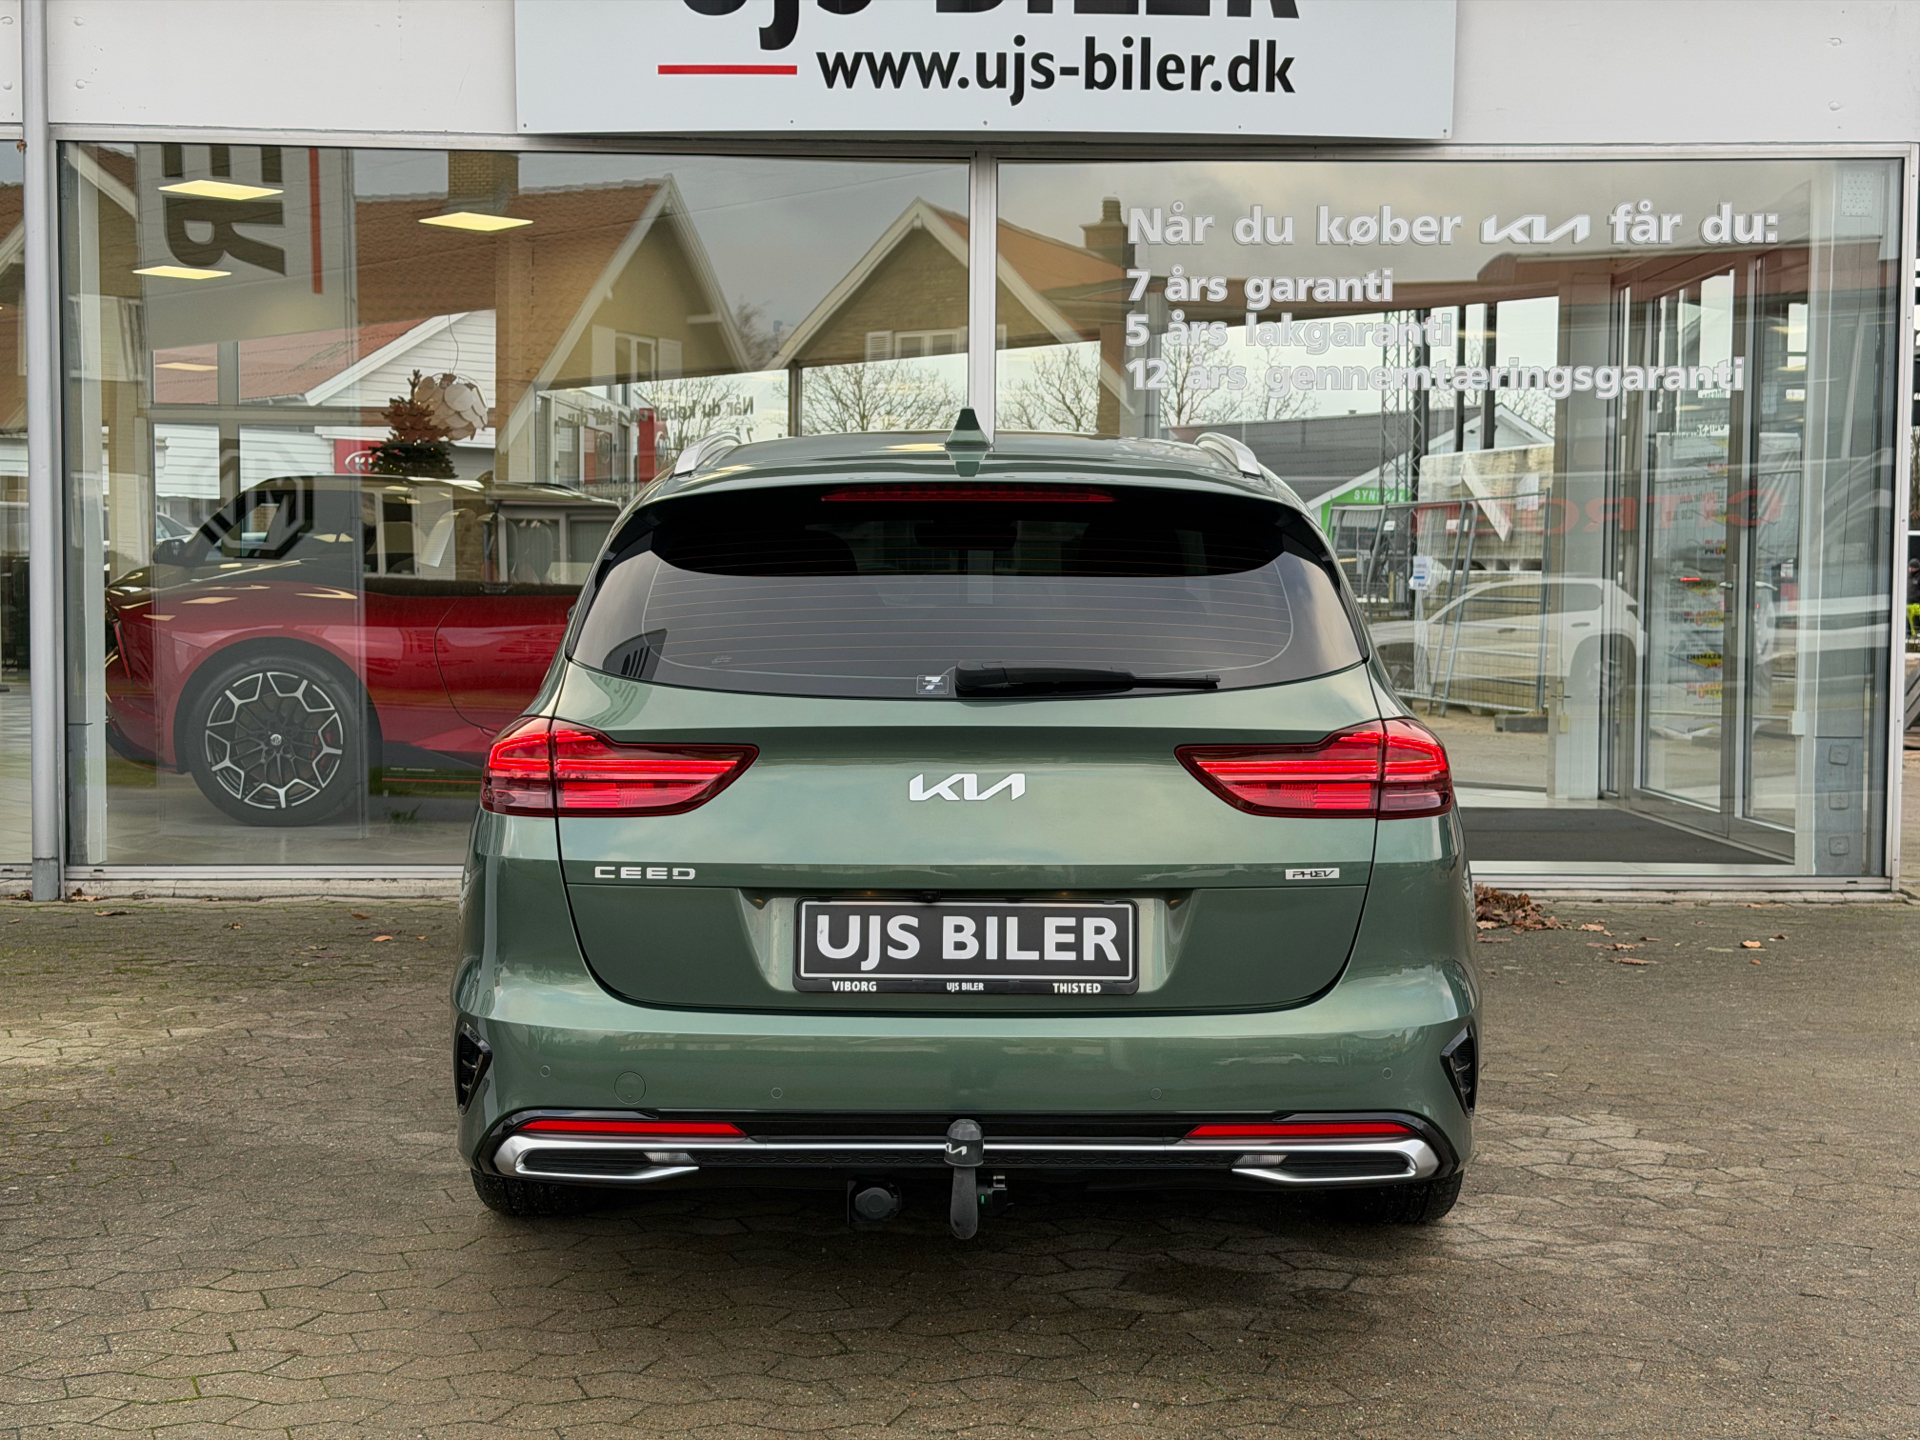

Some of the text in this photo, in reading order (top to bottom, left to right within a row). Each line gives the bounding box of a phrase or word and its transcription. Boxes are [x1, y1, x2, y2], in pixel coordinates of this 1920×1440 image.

[817, 35, 1296, 106] www.ujs-biler.dk
[1127, 200, 1214, 245] Når
[1233, 205, 1294, 245] du
[1316, 205, 1462, 246] køber
[1607, 200, 1682, 244] får
[1700, 202, 1778, 244] du:
[1126, 264, 1393, 310] 7 års garanti
[1126, 309, 1452, 355] 5 års lakgaranti
[1125, 354, 1745, 399] 12 års gennemtæringsgaranti
[594, 866, 696, 880] CEED
[1292, 869, 1335, 879] PHEV
[816, 914, 1121, 972] UJS BILER
[831, 981, 877, 992] VIBORG
[946, 982, 985, 992] UJS BILER
[1052, 982, 1102, 993] THISTED
